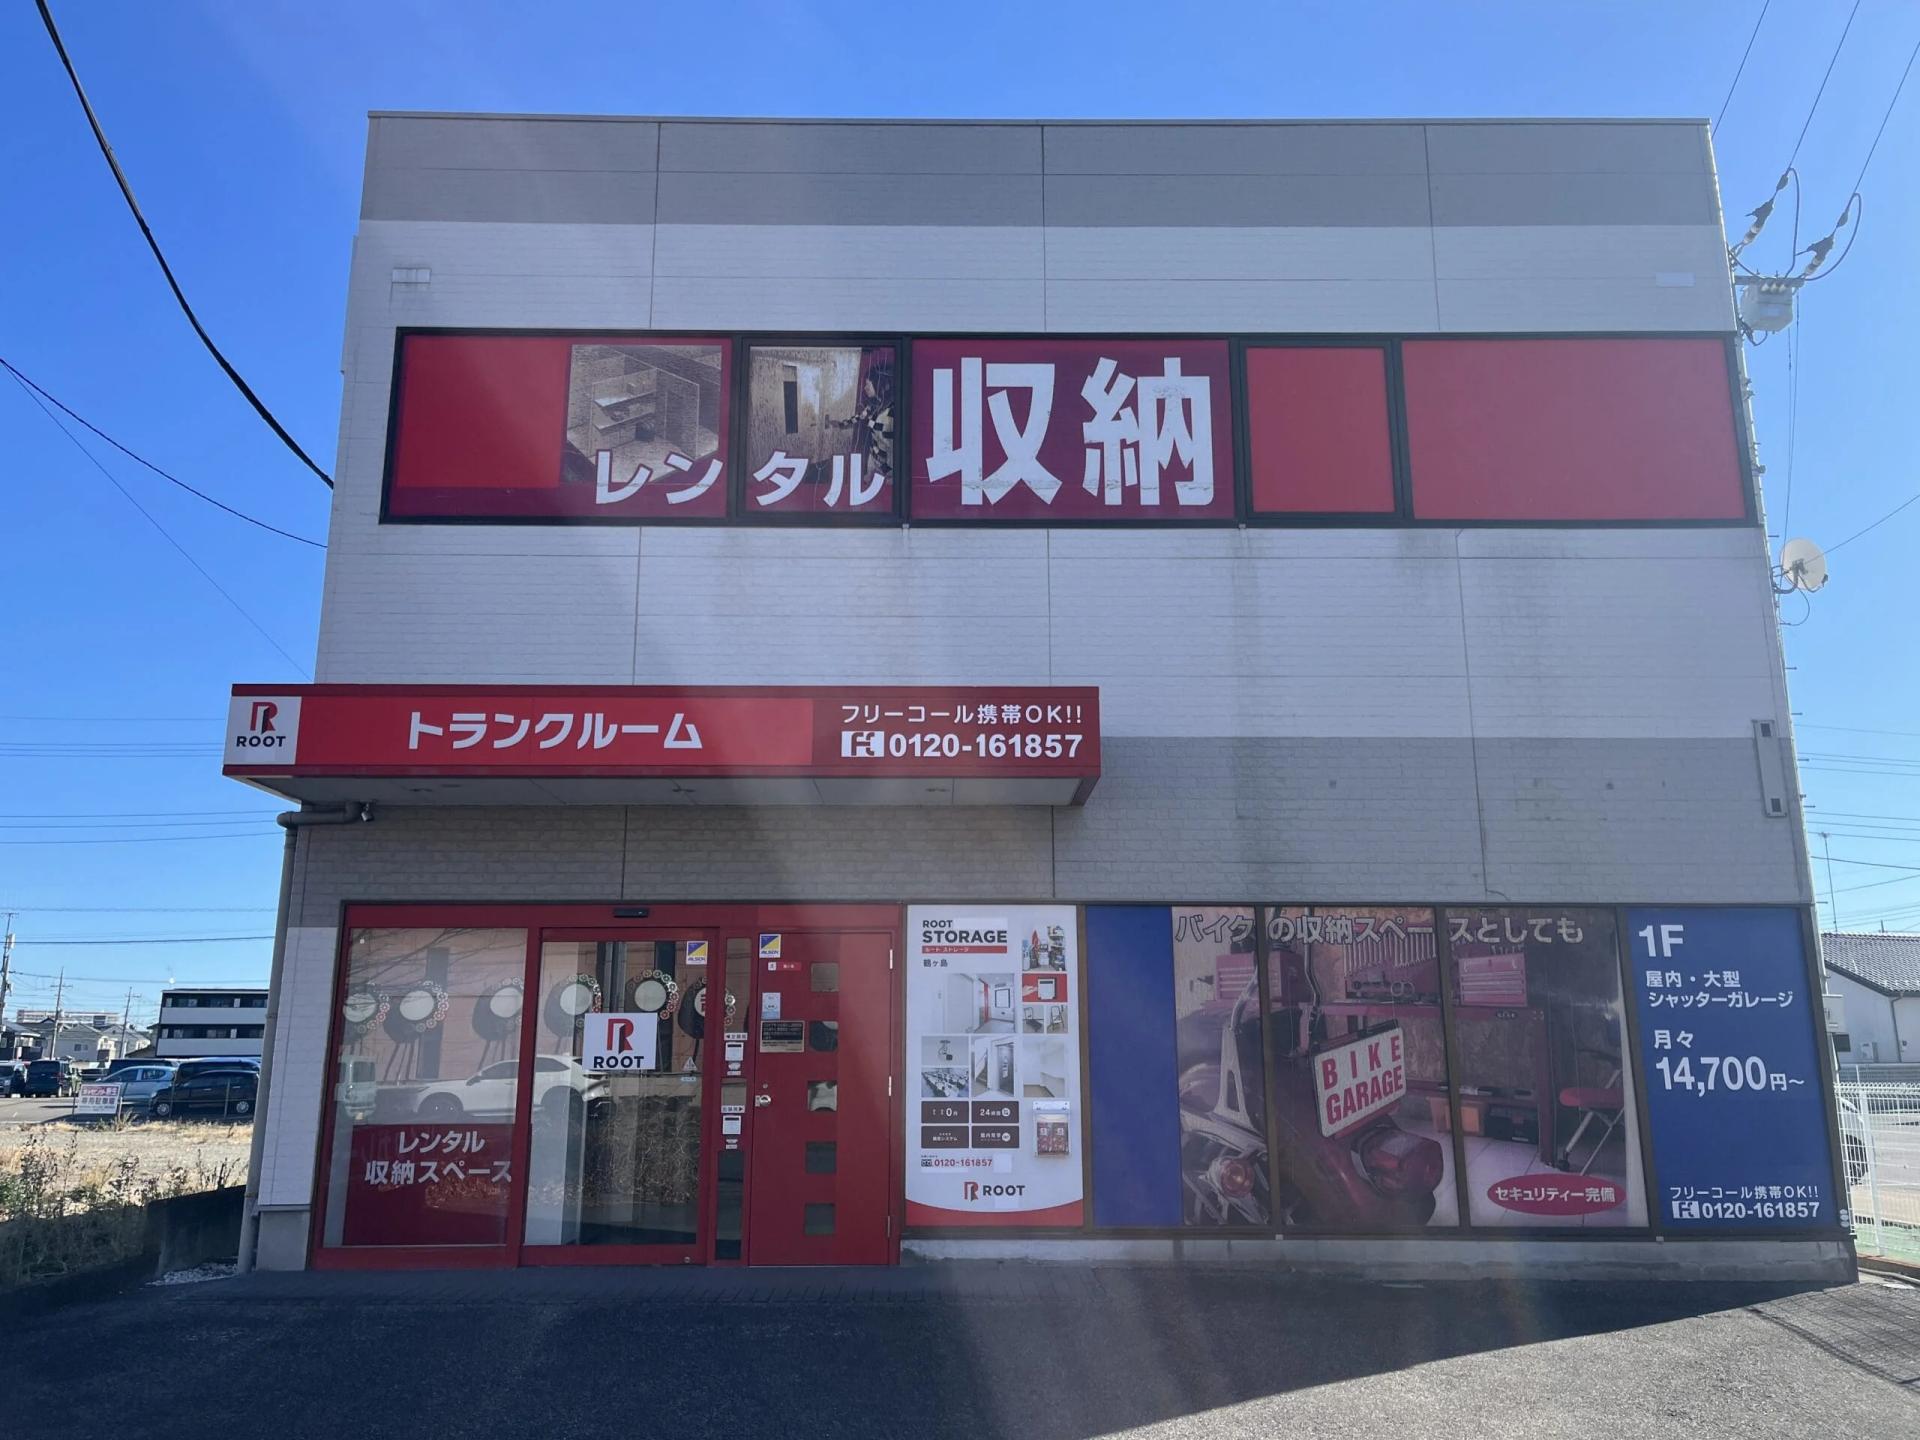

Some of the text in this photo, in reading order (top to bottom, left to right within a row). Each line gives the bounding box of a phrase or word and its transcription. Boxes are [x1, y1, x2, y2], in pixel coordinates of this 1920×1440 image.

[595, 356, 1214, 507] レンタル 収納
[841, 704, 1082, 725] フリーコール携帯OK!!
[408, 711, 703, 750] トランクルーム
[236, 735, 286, 748] ROOT
[889, 733, 1083, 758] 0120-161857
[922, 919, 953, 929] ROOT
[1175, 914, 1584, 945] バイクの収納スペースとしても
[922, 930, 1008, 944] STORAGE
[1638, 924, 1684, 957] 1F
[1645, 970, 1741, 988] 屋内・大型
[1648, 991, 1793, 1008] シャッターガレージ
[1654, 1030, 1694, 1050] 月々
[593, 1055, 644, 1069] ROOT
[1321, 1035, 1401, 1090] BIKE
[1326, 1065, 1404, 1125] GARAGE
[398, 1130, 486, 1155] レンタル
[364, 1160, 512, 1185] 収納スペース
[982, 1185, 1026, 1196] ROOT
[1494, 1186, 1616, 1204] セキュリティー完備
[1701, 1202, 1820, 1219] 0120-161857
